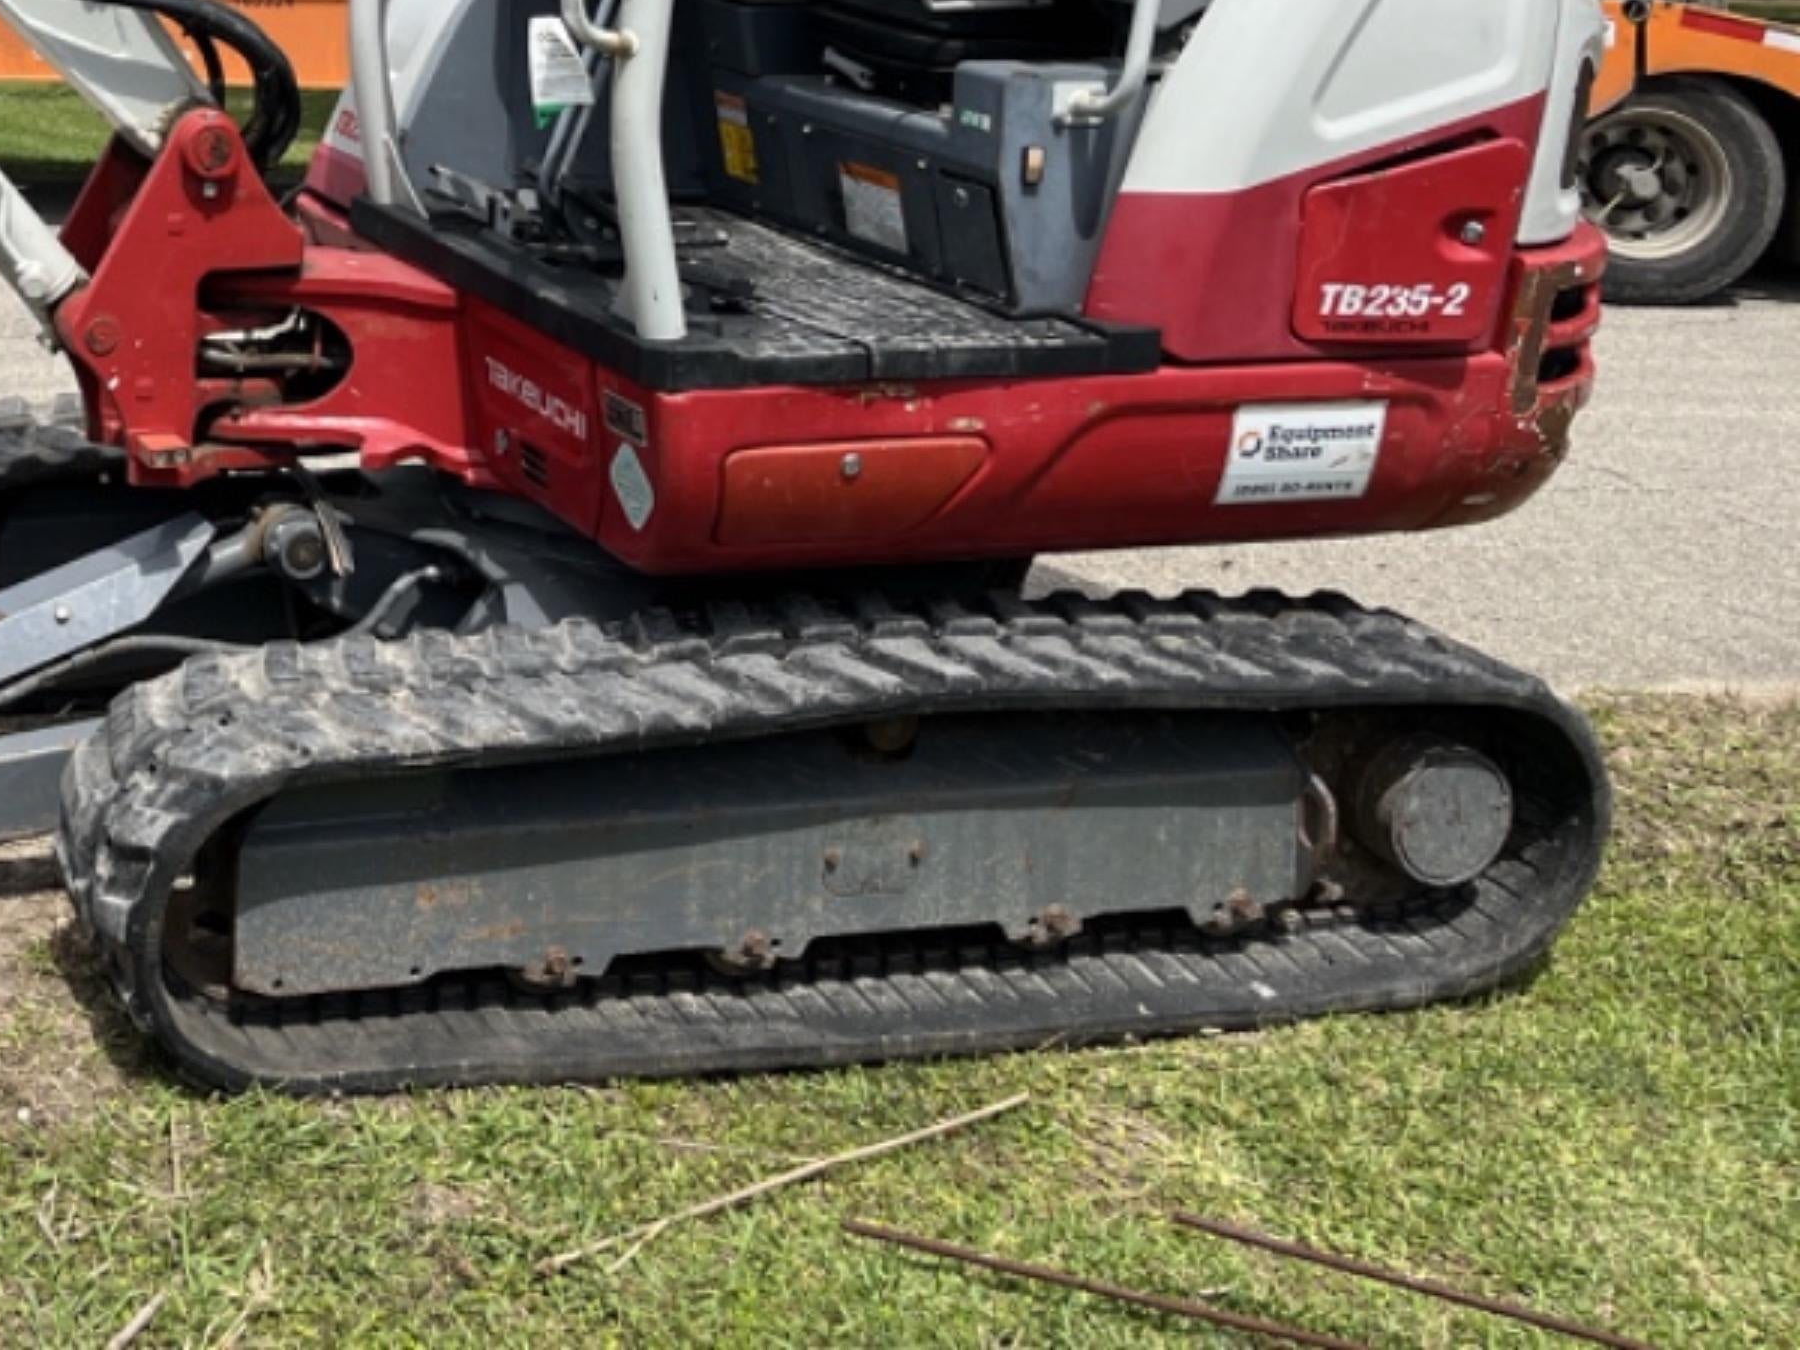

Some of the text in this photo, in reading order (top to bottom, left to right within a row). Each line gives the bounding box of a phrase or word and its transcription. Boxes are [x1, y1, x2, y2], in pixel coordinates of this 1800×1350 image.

[1319, 281, 1472, 317] TB235-2
[1267, 423, 1375, 444] Equipment
[1263, 445, 1324, 462] Share
